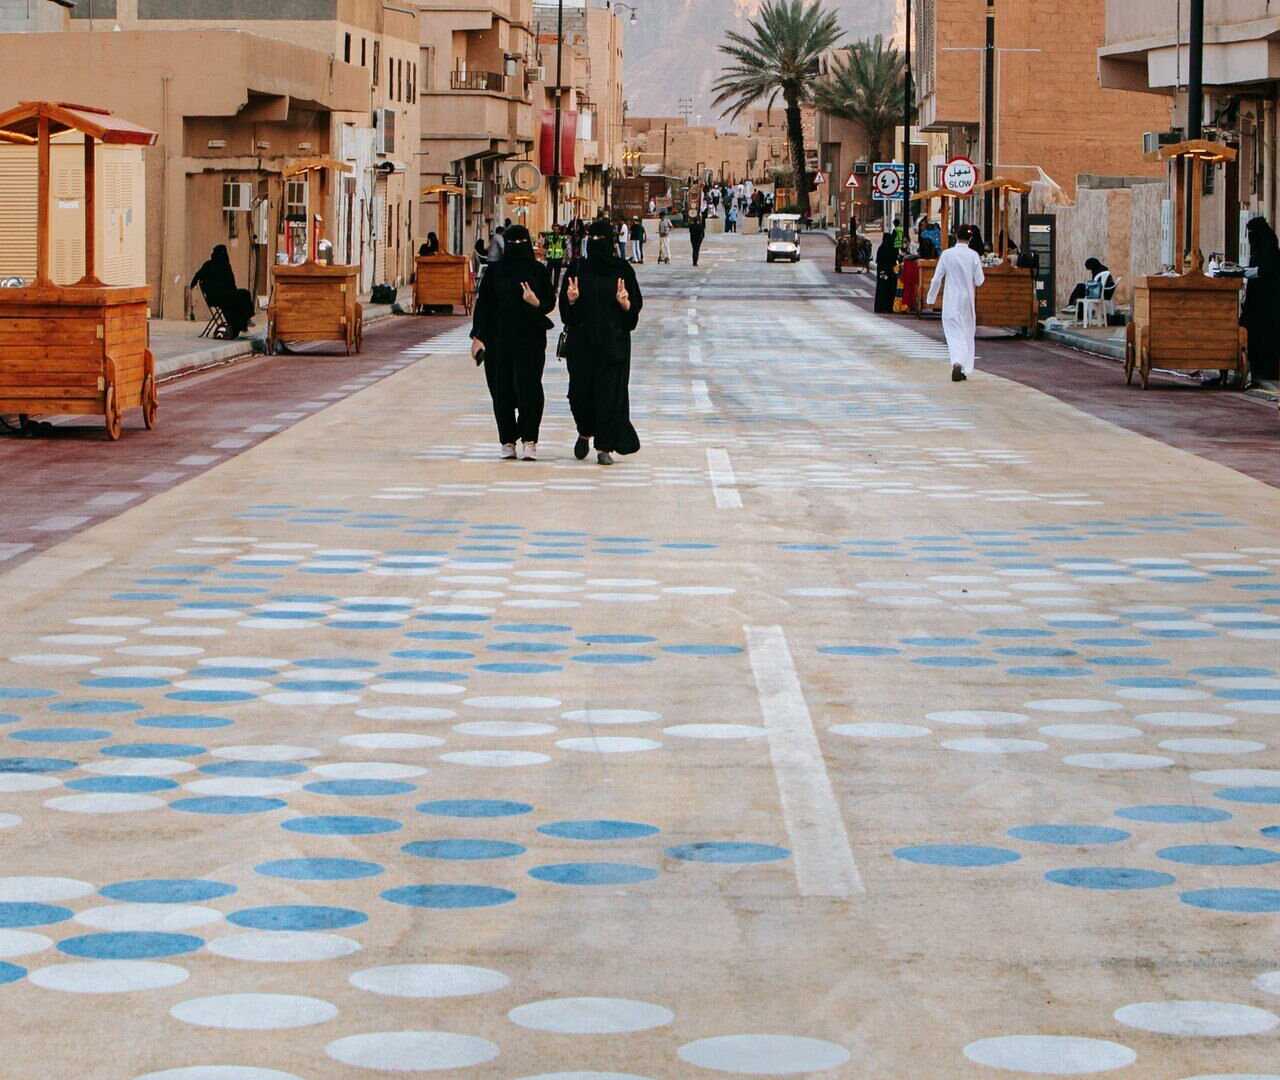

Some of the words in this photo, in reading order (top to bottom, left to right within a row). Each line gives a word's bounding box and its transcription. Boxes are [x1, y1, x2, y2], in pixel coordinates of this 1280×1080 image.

[949, 166, 971, 177] تمهل
[881, 175, 896, 189] ٤٠
[949, 180, 972, 188] SLOW
